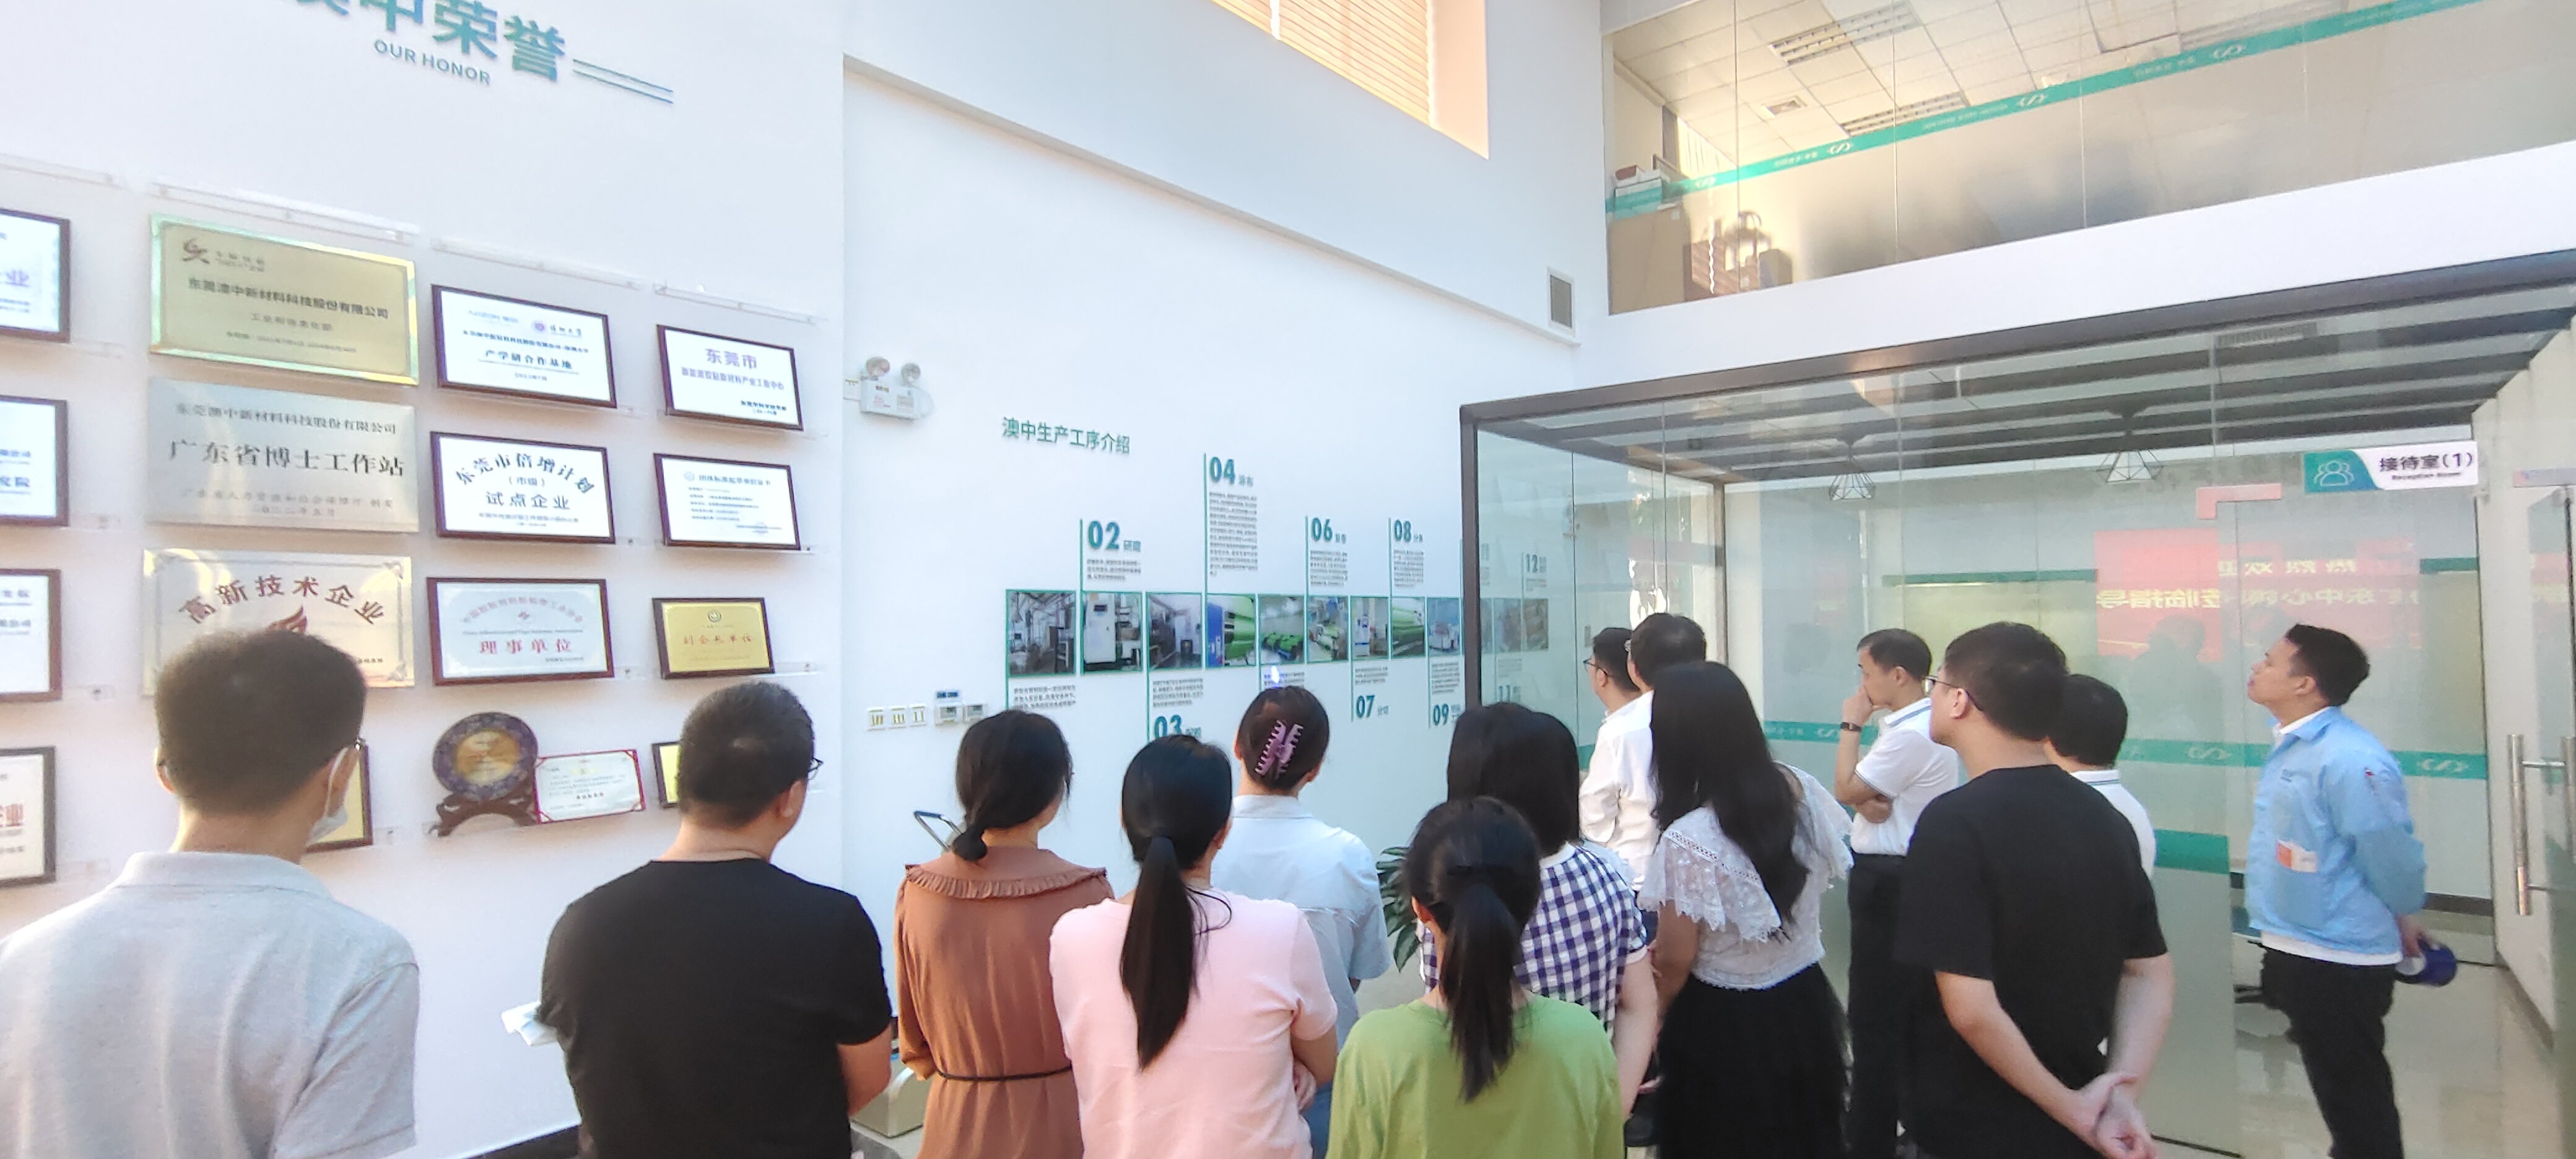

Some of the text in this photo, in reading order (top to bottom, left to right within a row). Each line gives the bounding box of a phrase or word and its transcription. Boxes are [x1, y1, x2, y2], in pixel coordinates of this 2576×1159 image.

[297, 0, 565, 81] 中荣誉
[374, 39, 490, 86] OUR HONOR
[189, 277, 389, 319] 东莞澳中新材料科技股份有限公司
[485, 349, 573, 370] 产学研合作基地
[705, 348, 757, 370] 东莞市
[176, 403, 396, 435] 东莞澳中新材料科技股份有限公司
[1001, 416, 1130, 454] 澳中生产工序介绍
[168, 438, 404, 477] 广东省博士工作站
[1209, 456, 1235, 485] 04
[456, 453, 594, 493] 东莞市倍增计划
[487, 491, 570, 510] 试点企业
[1087, 520, 1121, 551] 02
[1311, 517, 1333, 542] 06
[1393, 519, 1412, 542] 08
[1526, 553, 1538, 573] 12
[178, 574, 385, 625] 高新技术企业
[479, 638, 572, 655] 理事单位
[1355, 695, 1375, 718] 07
[1432, 703, 1450, 726] 09
[1154, 714, 1182, 739] 03
